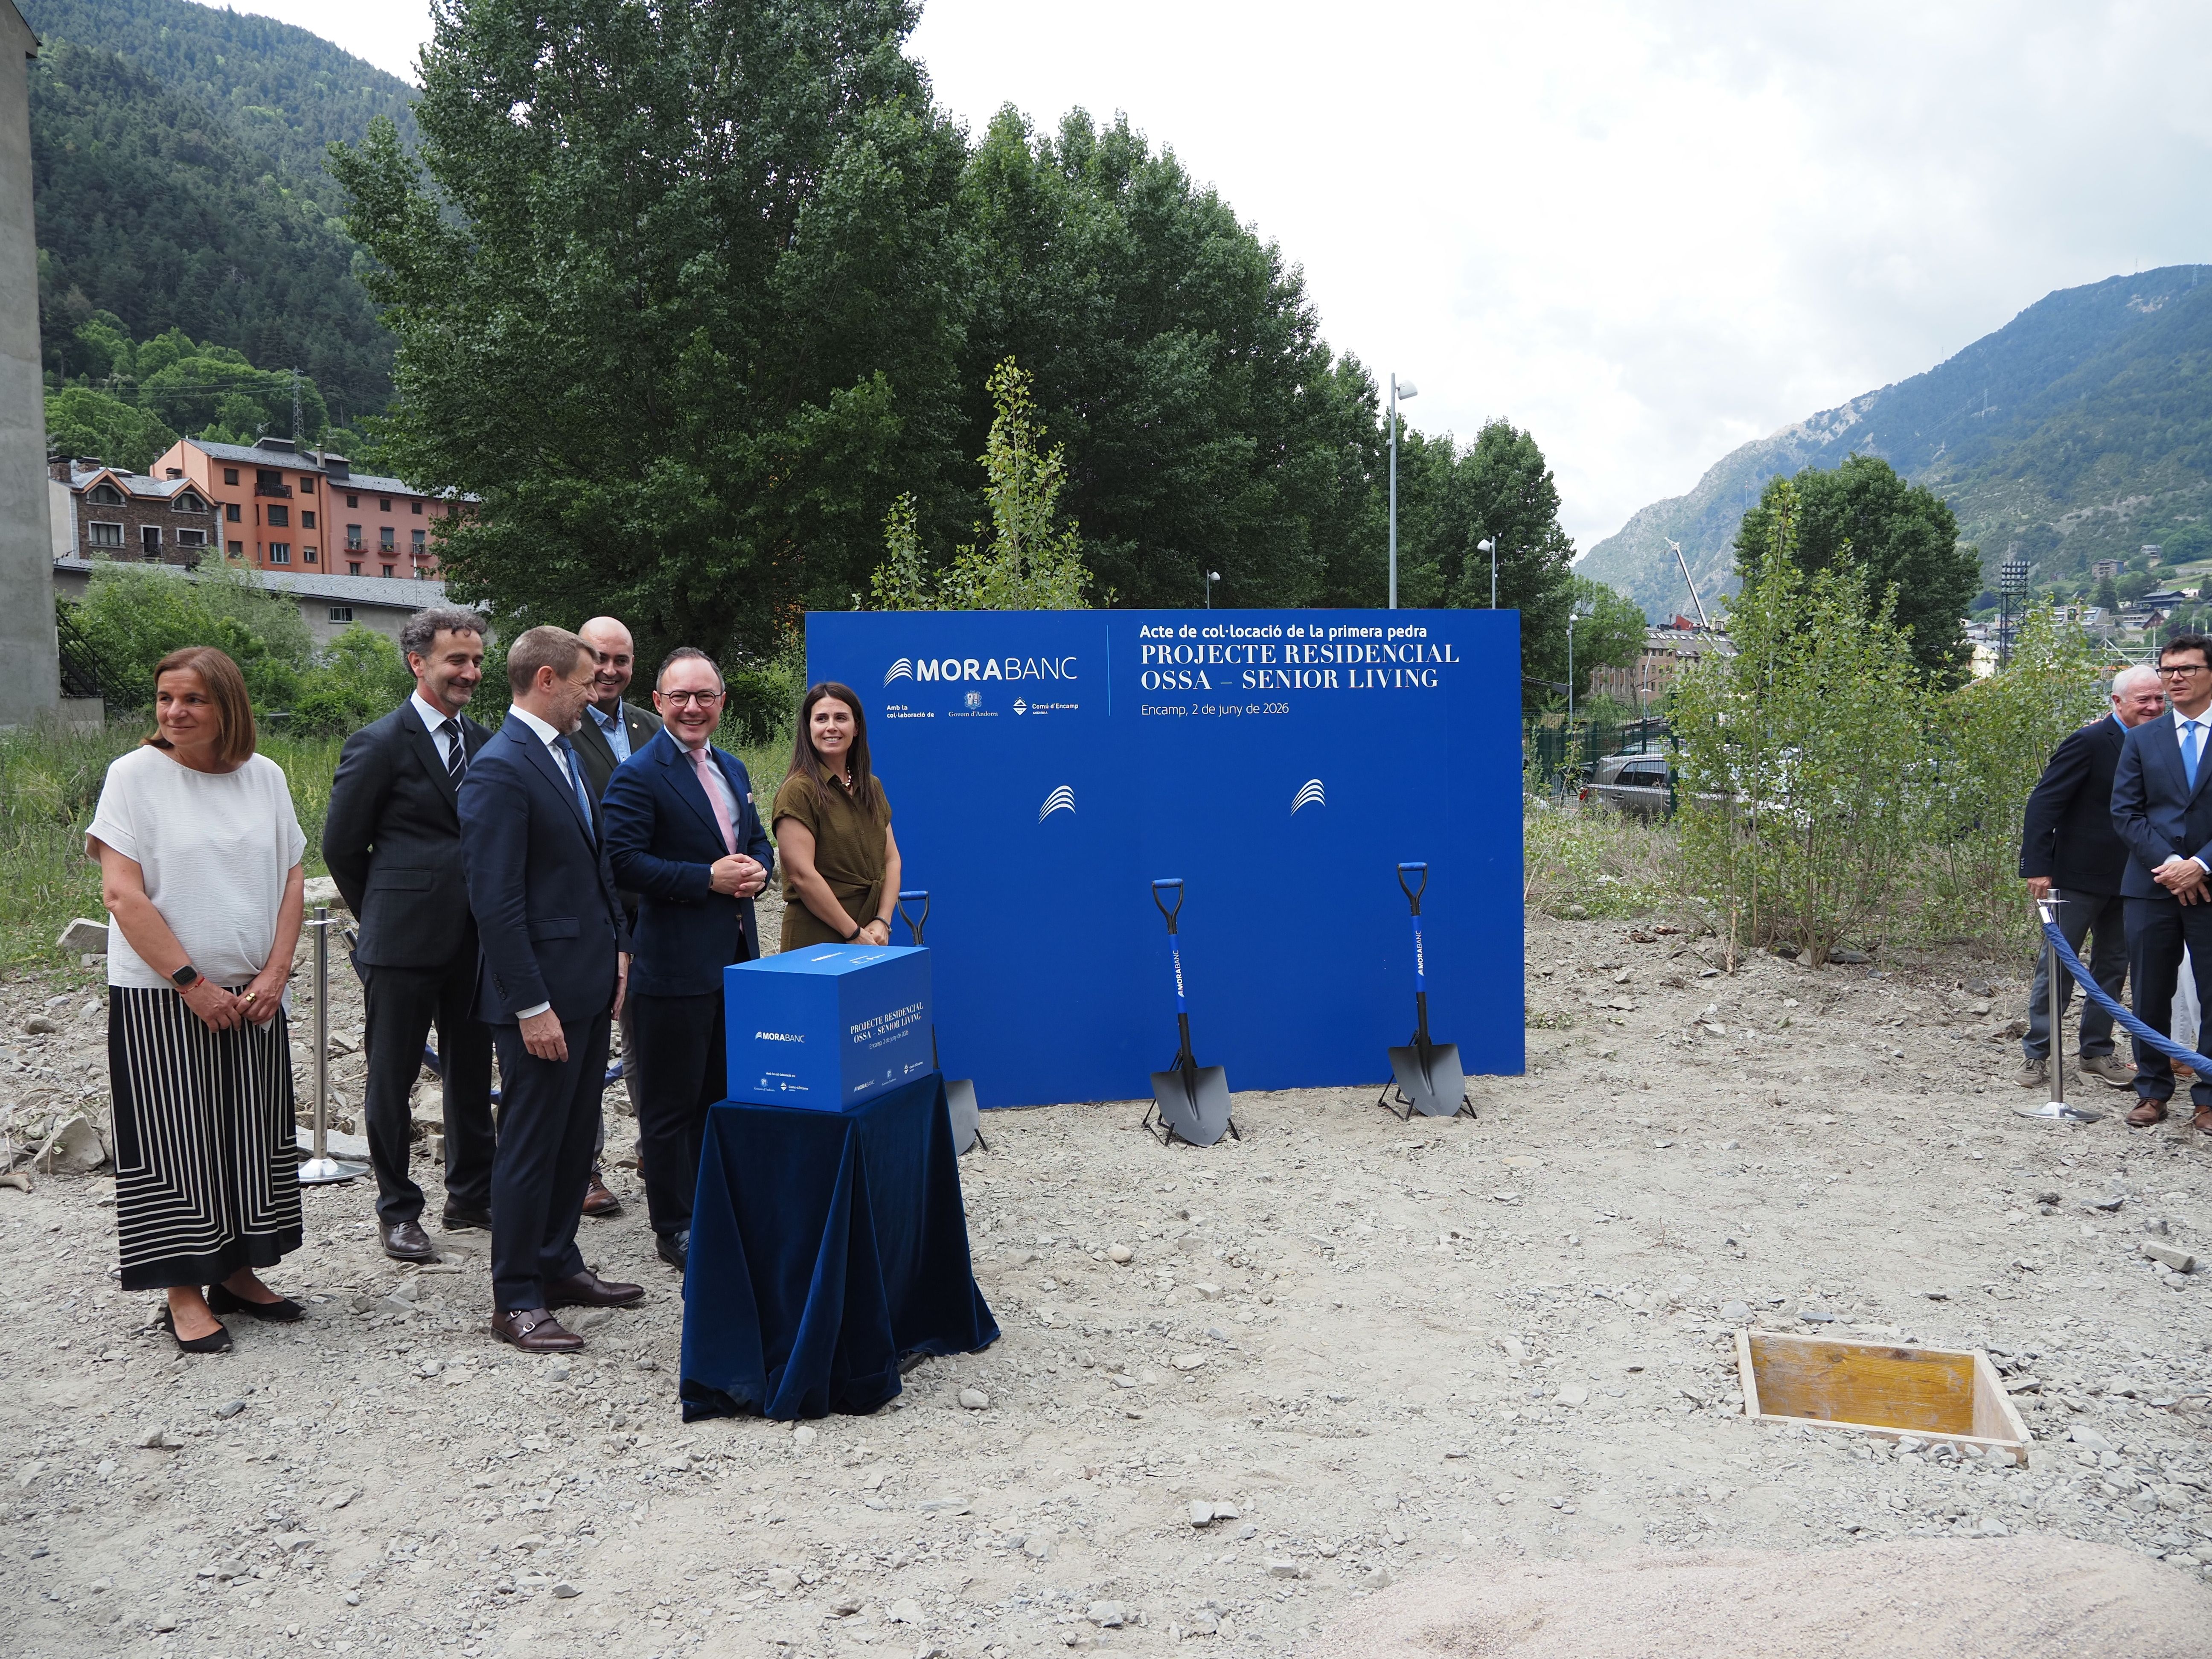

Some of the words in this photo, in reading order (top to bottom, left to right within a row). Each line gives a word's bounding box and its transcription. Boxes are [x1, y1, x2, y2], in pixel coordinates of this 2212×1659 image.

[1139, 625, 1174, 638] Acte
[1179, 624, 1197, 638] de
[1202, 624, 1282, 638] col·locació
[1286, 624, 1304, 638] de
[1310, 624, 1324, 637] la
[1329, 625, 1382, 641] primera
[1388, 624, 1427, 641] pedra
[1140, 644, 1276, 664] PROJECTE
[1284, 643, 1460, 664] RESIDENCIAL
[917, 657, 1077, 681] MORABANC
[1141, 669, 1212, 690] OSSA
[1243, 669, 1339, 689] SENIOR
[1348, 669, 1438, 688] LIVING
[1141, 704, 1188, 718] Encamp,
[1192, 704, 1198, 715] 2
[1202, 704, 1215, 715] de
[1218, 704, 1243, 717] juny
[1246, 703, 1260, 714] de
[1263, 703, 1289, 714] 2026
[1415, 930, 1424, 969] MORABANC
[1172, 949, 1184, 990] MORABANC
[850, 1016, 883, 1035] PROJECTE
[885, 1002, 923, 1023] RESIDENCIAL
[854, 1030, 871, 1043] OSSA
[877, 1020, 899, 1035] SENIOR
[901, 1012, 921, 1026] LIVING
[763, 1032, 805, 1043] MORABANC
